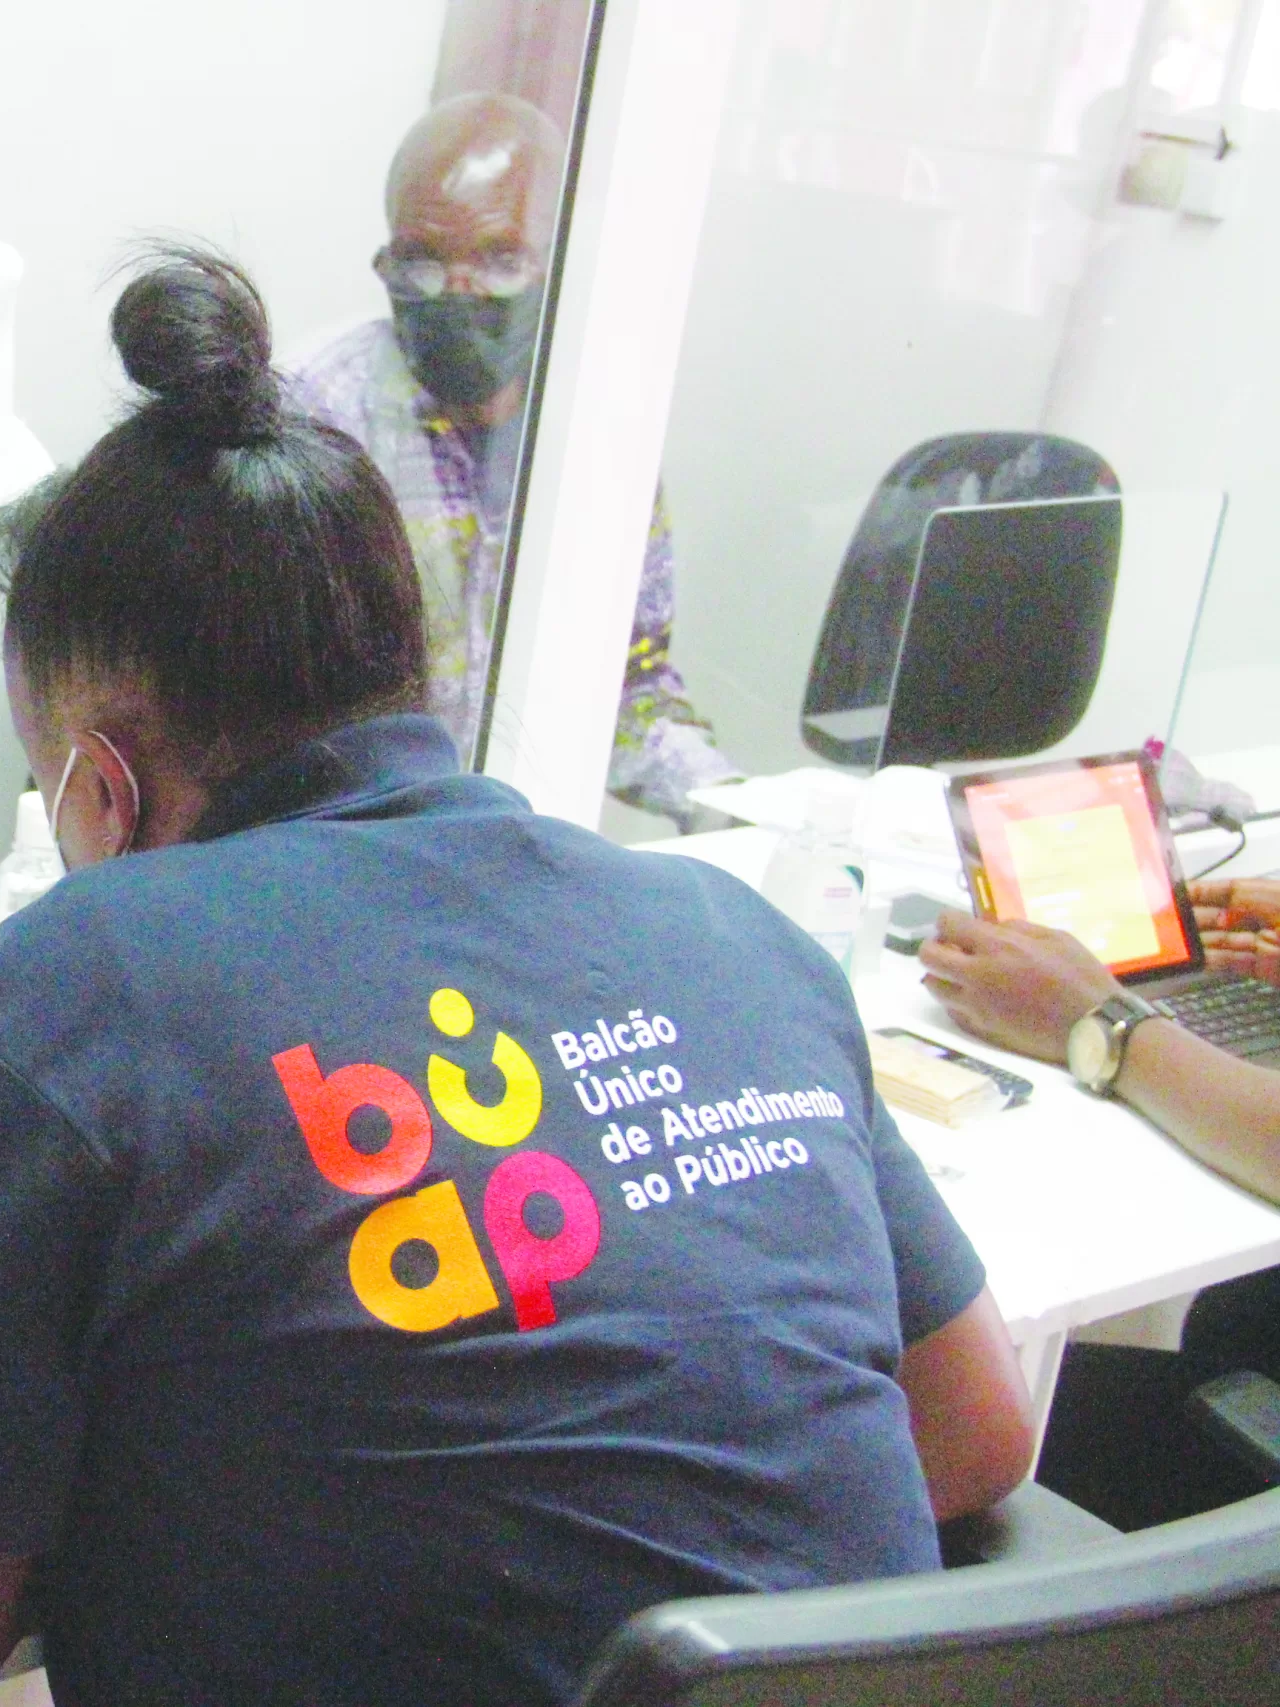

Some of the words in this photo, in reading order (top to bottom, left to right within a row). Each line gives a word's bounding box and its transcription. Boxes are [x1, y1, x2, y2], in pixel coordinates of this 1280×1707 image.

[551, 1009, 678, 1070] Balcão
[573, 1064, 683, 1115] Único
[600, 1123, 652, 1163] de
[661, 1086, 844, 1147] Atendimento
[619, 1173, 671, 1210] ao
[673, 1136, 809, 1194] Público
[348, 1151, 601, 1332] ap
